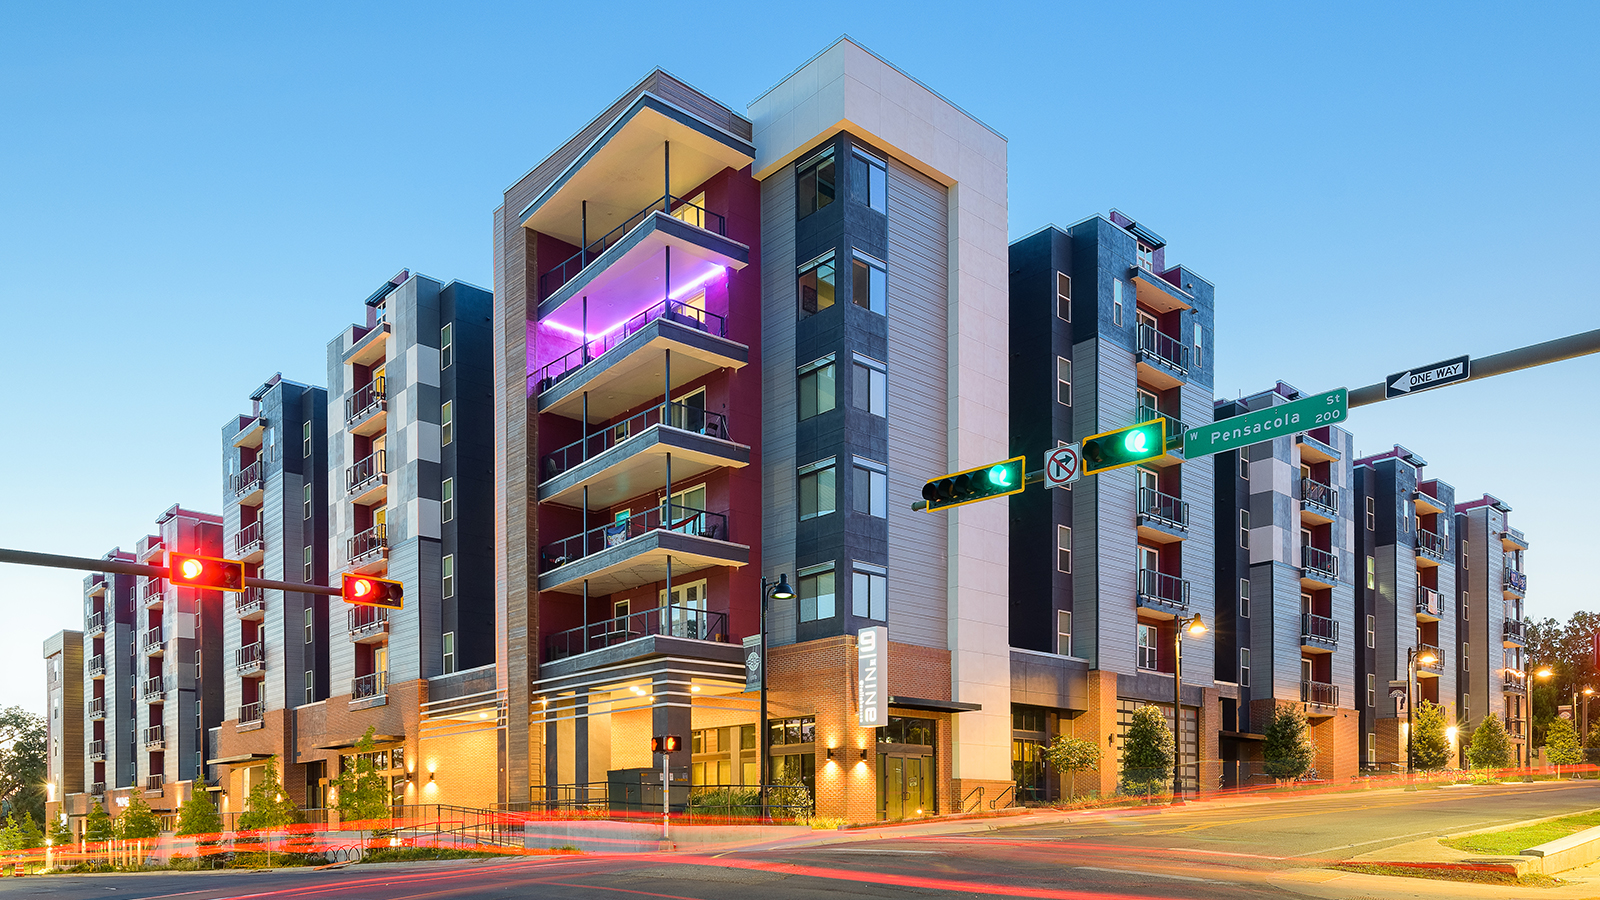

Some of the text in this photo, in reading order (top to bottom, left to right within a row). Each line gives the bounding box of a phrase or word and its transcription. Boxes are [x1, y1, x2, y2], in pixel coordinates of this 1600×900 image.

[1410, 364, 1460, 385] ONE WAY
[1190, 394, 1340, 444] W Pensacola St
[1315, 409, 1340, 424] 200
[860, 630, 876, 653] 9
